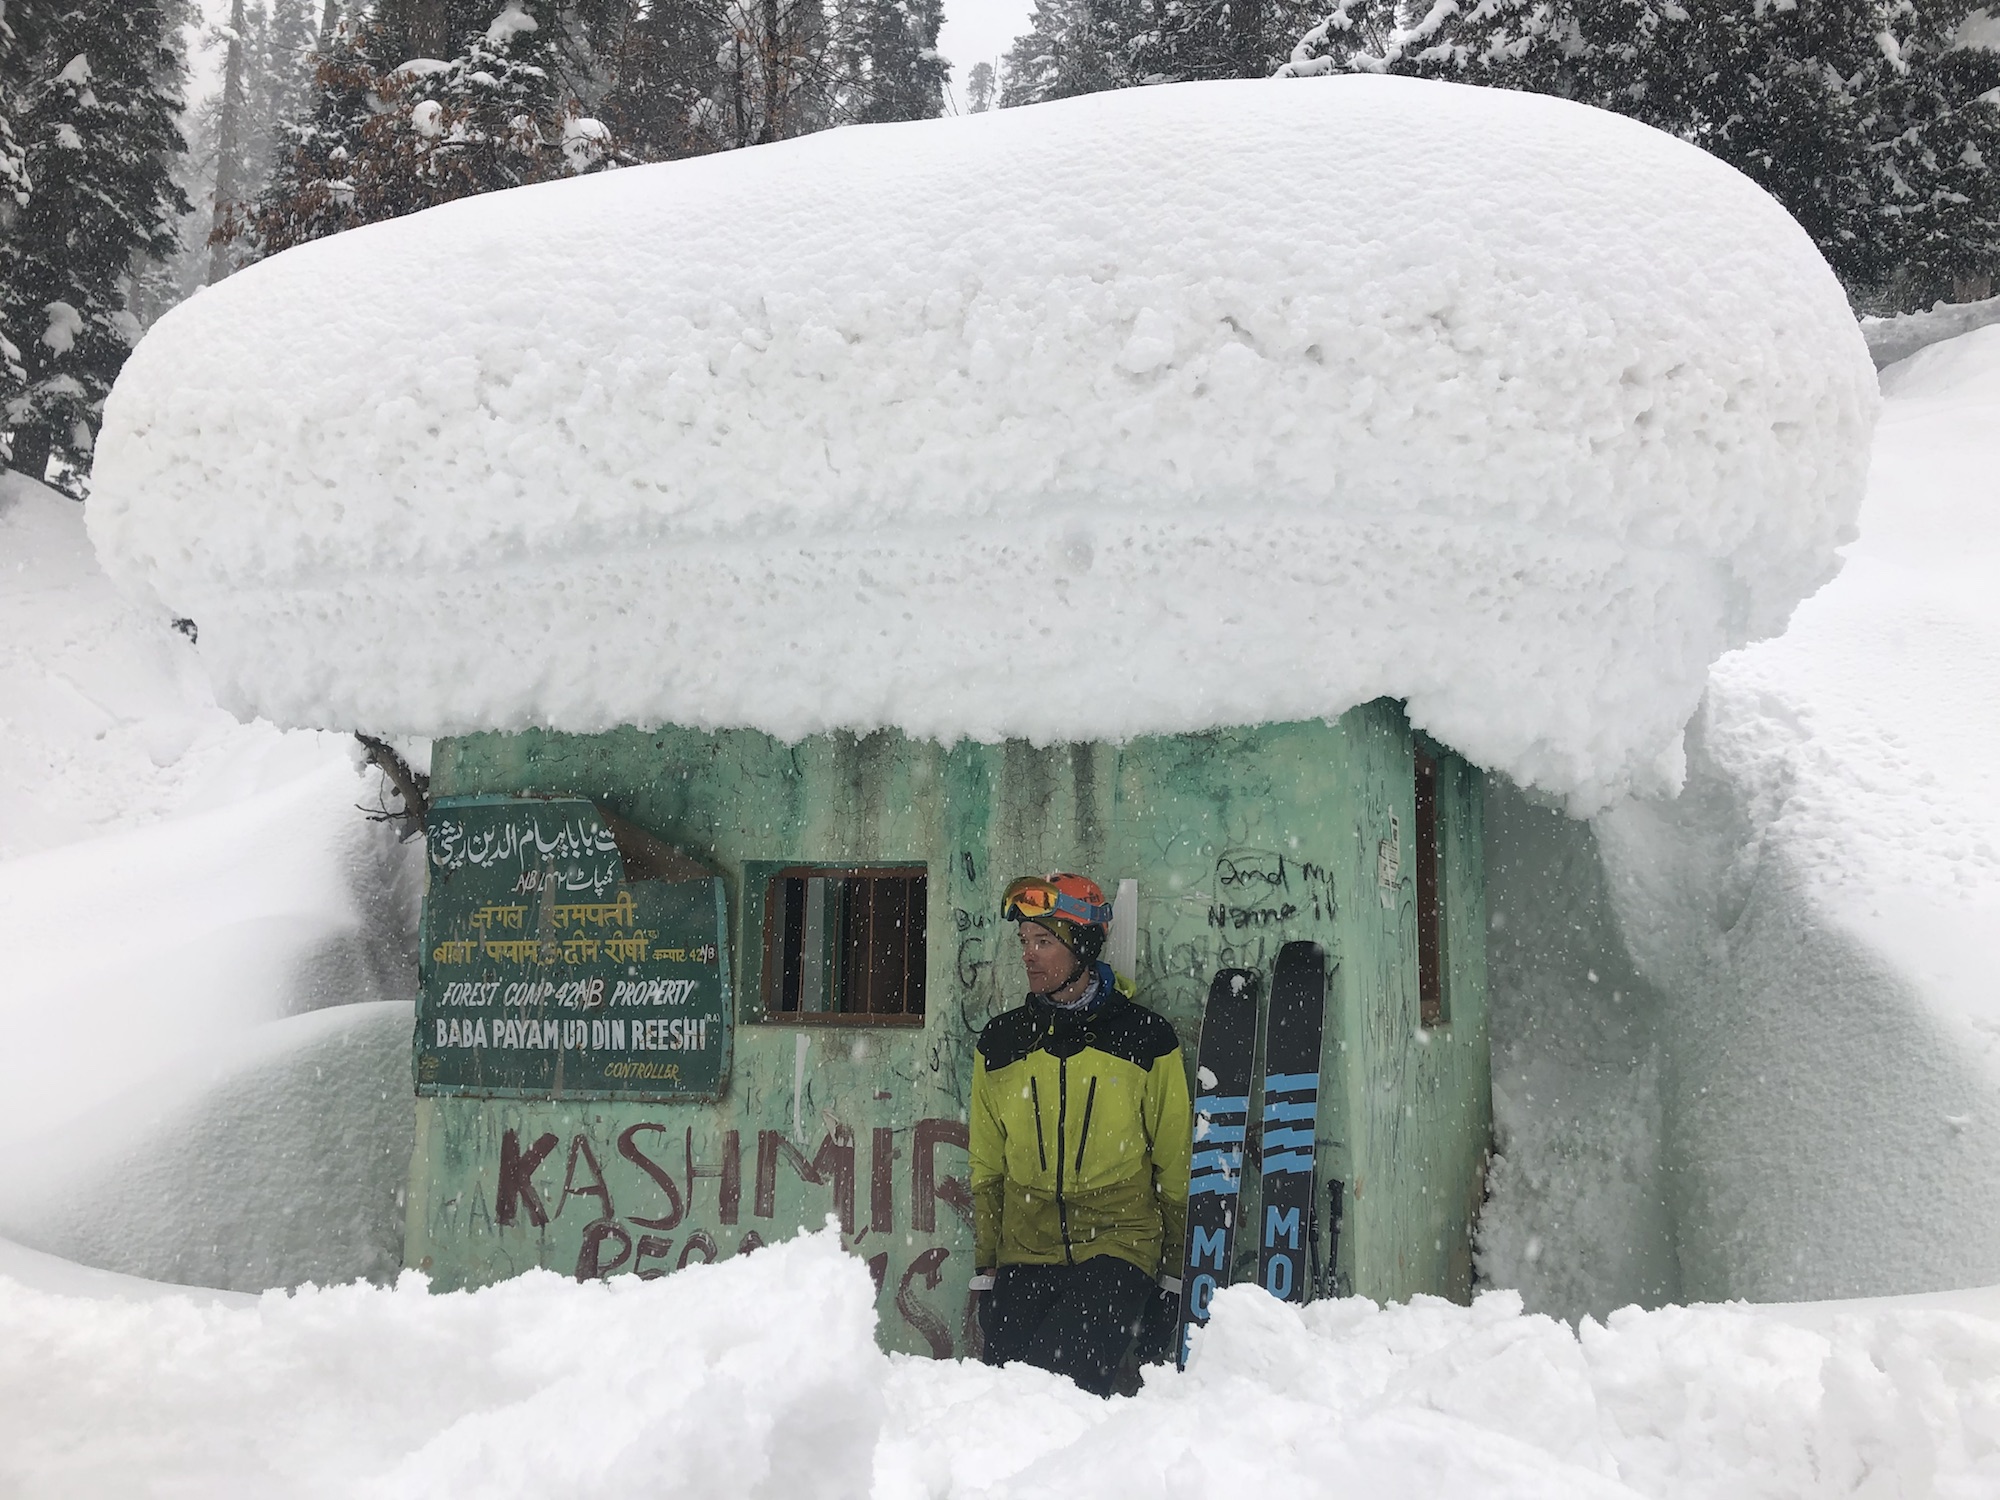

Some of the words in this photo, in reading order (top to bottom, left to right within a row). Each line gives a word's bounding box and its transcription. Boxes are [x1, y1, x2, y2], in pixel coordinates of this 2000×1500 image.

[442, 981, 501, 1007] FOREST
[609, 979, 695, 1007] PROPERTY
[435, 1018, 488, 1049] BABA
[492, 1018, 558, 1050] PAYAM
[592, 1019, 625, 1050] DIN
[631, 1018, 706, 1051] REESHI
[604, 1061, 682, 1083] CONTROLLER
[495, 1118, 975, 1235] KASHMIR
